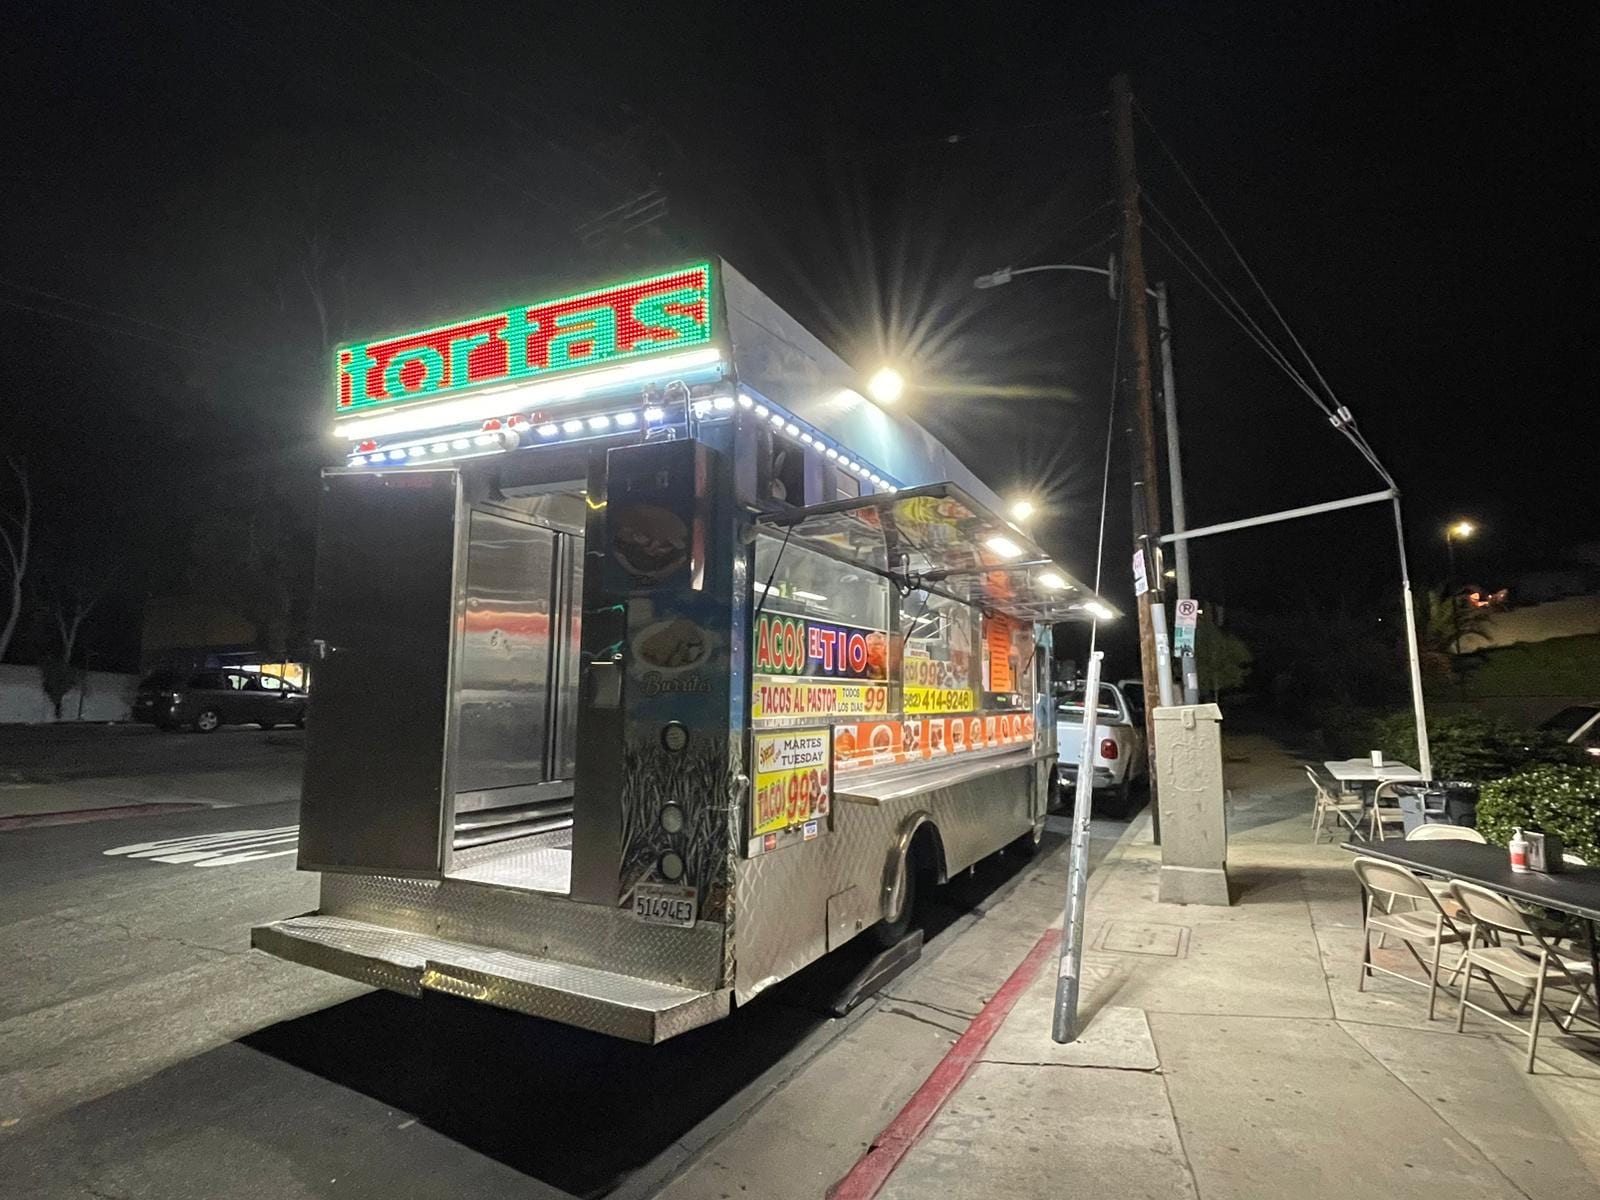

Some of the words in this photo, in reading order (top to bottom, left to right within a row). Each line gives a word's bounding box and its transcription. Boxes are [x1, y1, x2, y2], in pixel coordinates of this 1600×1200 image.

[342, 289, 706, 406] tortas
[755, 617, 805, 672] ACOS
[808, 627, 823, 659] EL
[820, 629, 867, 673] TIO
[761, 686, 792, 713] TACOS
[794, 688, 804, 713] AL
[807, 687, 837, 713] PASTOR
[842, 688, 860, 698] TODOS
[838, 703, 849, 712] LOS
[783, 738, 822, 751] MARTES
[781, 751, 824, 766] TUESDAY
[787, 772, 809, 820] 99
[636, 896, 693, 921] 51494E3
